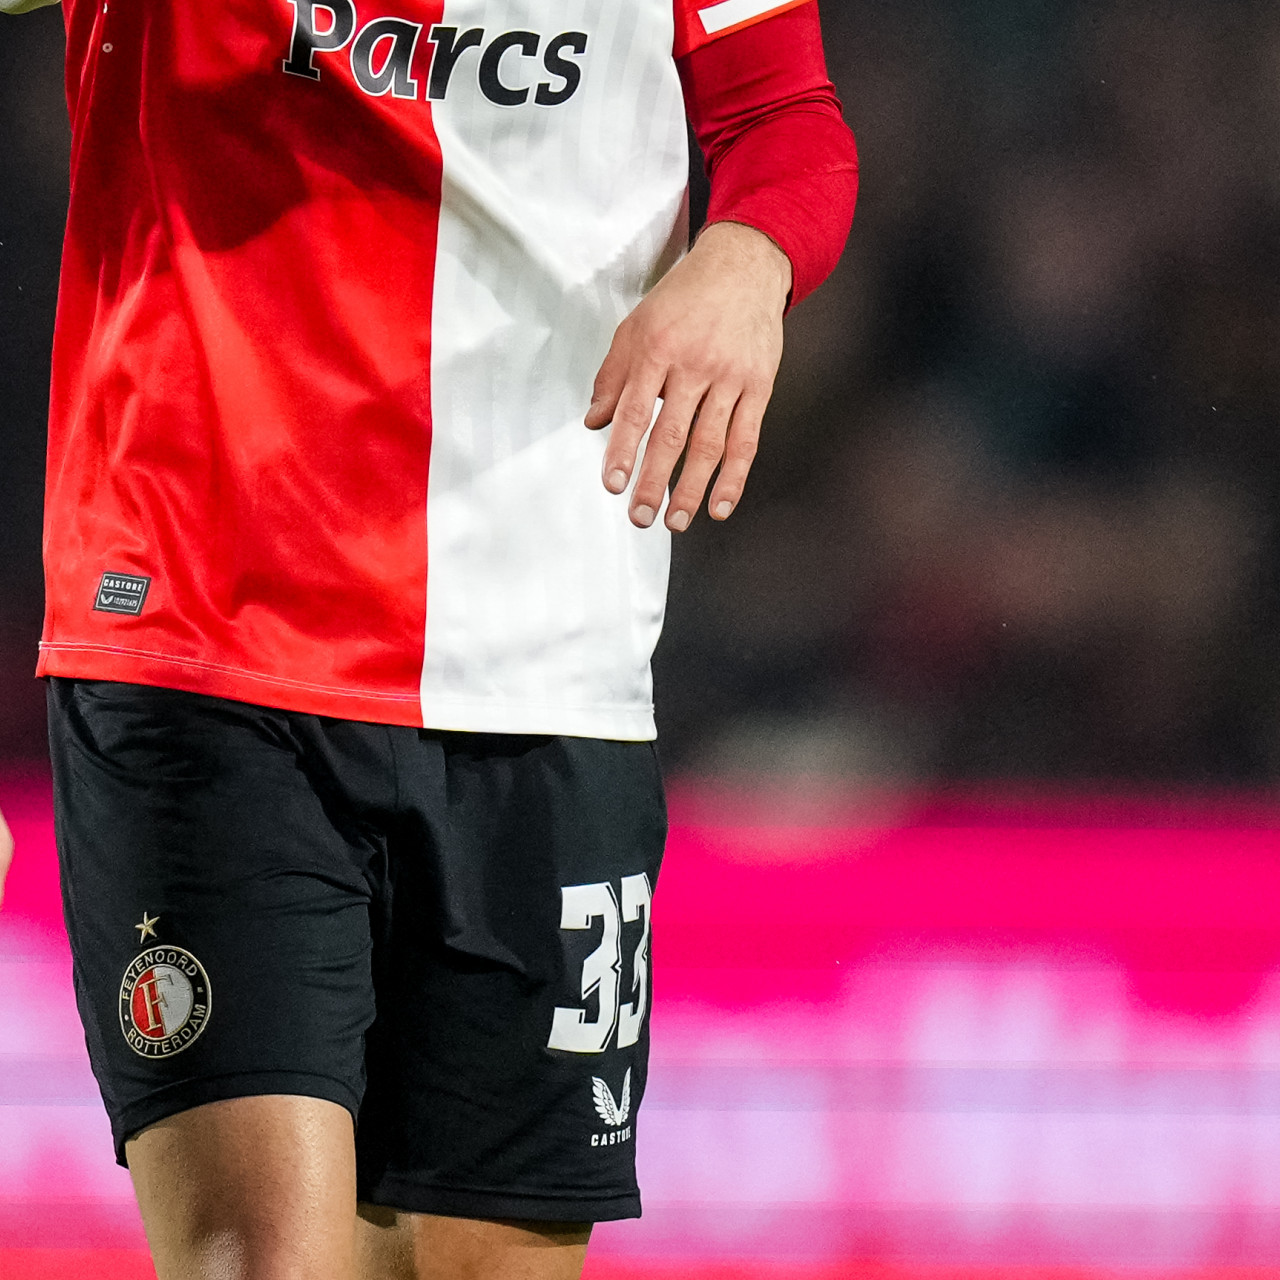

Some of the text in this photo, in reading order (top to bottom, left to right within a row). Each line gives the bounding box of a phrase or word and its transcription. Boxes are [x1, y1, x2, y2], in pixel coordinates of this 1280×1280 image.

[103, 578, 143, 592] CASTORE
[122, 950, 198, 1000] FEYENOORD
[546, 872, 652, 1053] 33
[127, 1003, 207, 1054] ROTTERDAM
